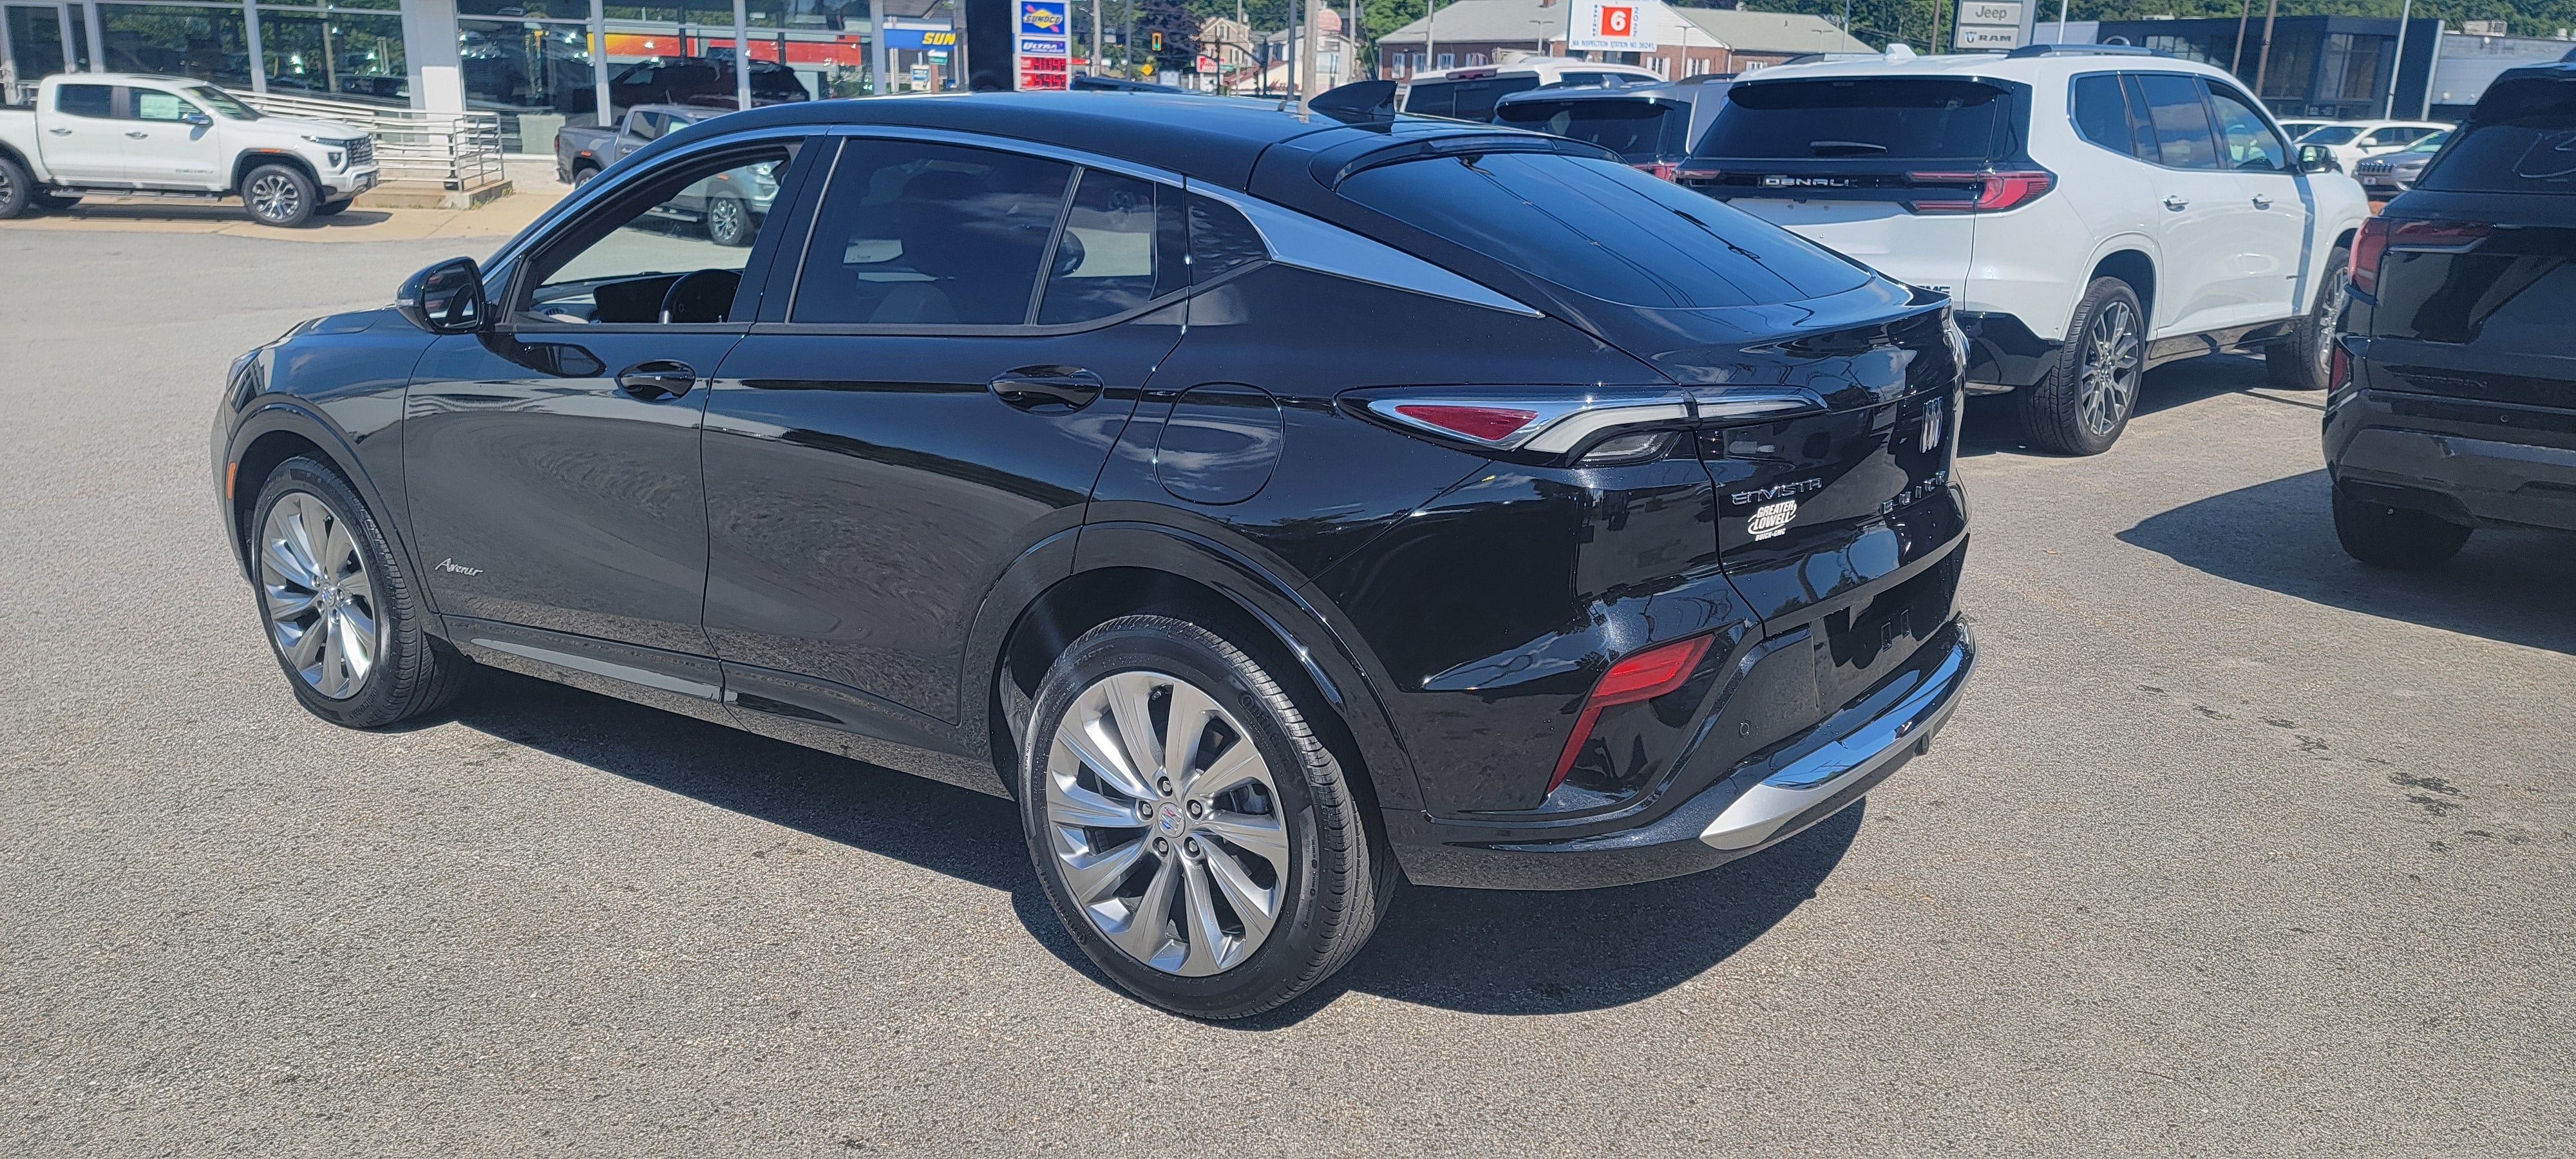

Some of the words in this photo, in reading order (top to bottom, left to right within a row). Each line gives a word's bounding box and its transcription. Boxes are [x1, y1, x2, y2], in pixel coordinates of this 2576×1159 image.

[1025, 15, 1061, 24] SUNOCO
[1611, 10, 1626, 31] 6
[1976, 5, 2007, 21] Jeep
[922, 32, 956, 44] SUN
[1023, 42, 1057, 50] ULTRA
[1765, 178, 1849, 187] DENALI
[1732, 477, 1822, 505] ENVISTA
[1757, 500, 1796, 518] GREATER
[1753, 511, 1790, 531] LOWELL
[435, 558, 484, 576] Avenir
